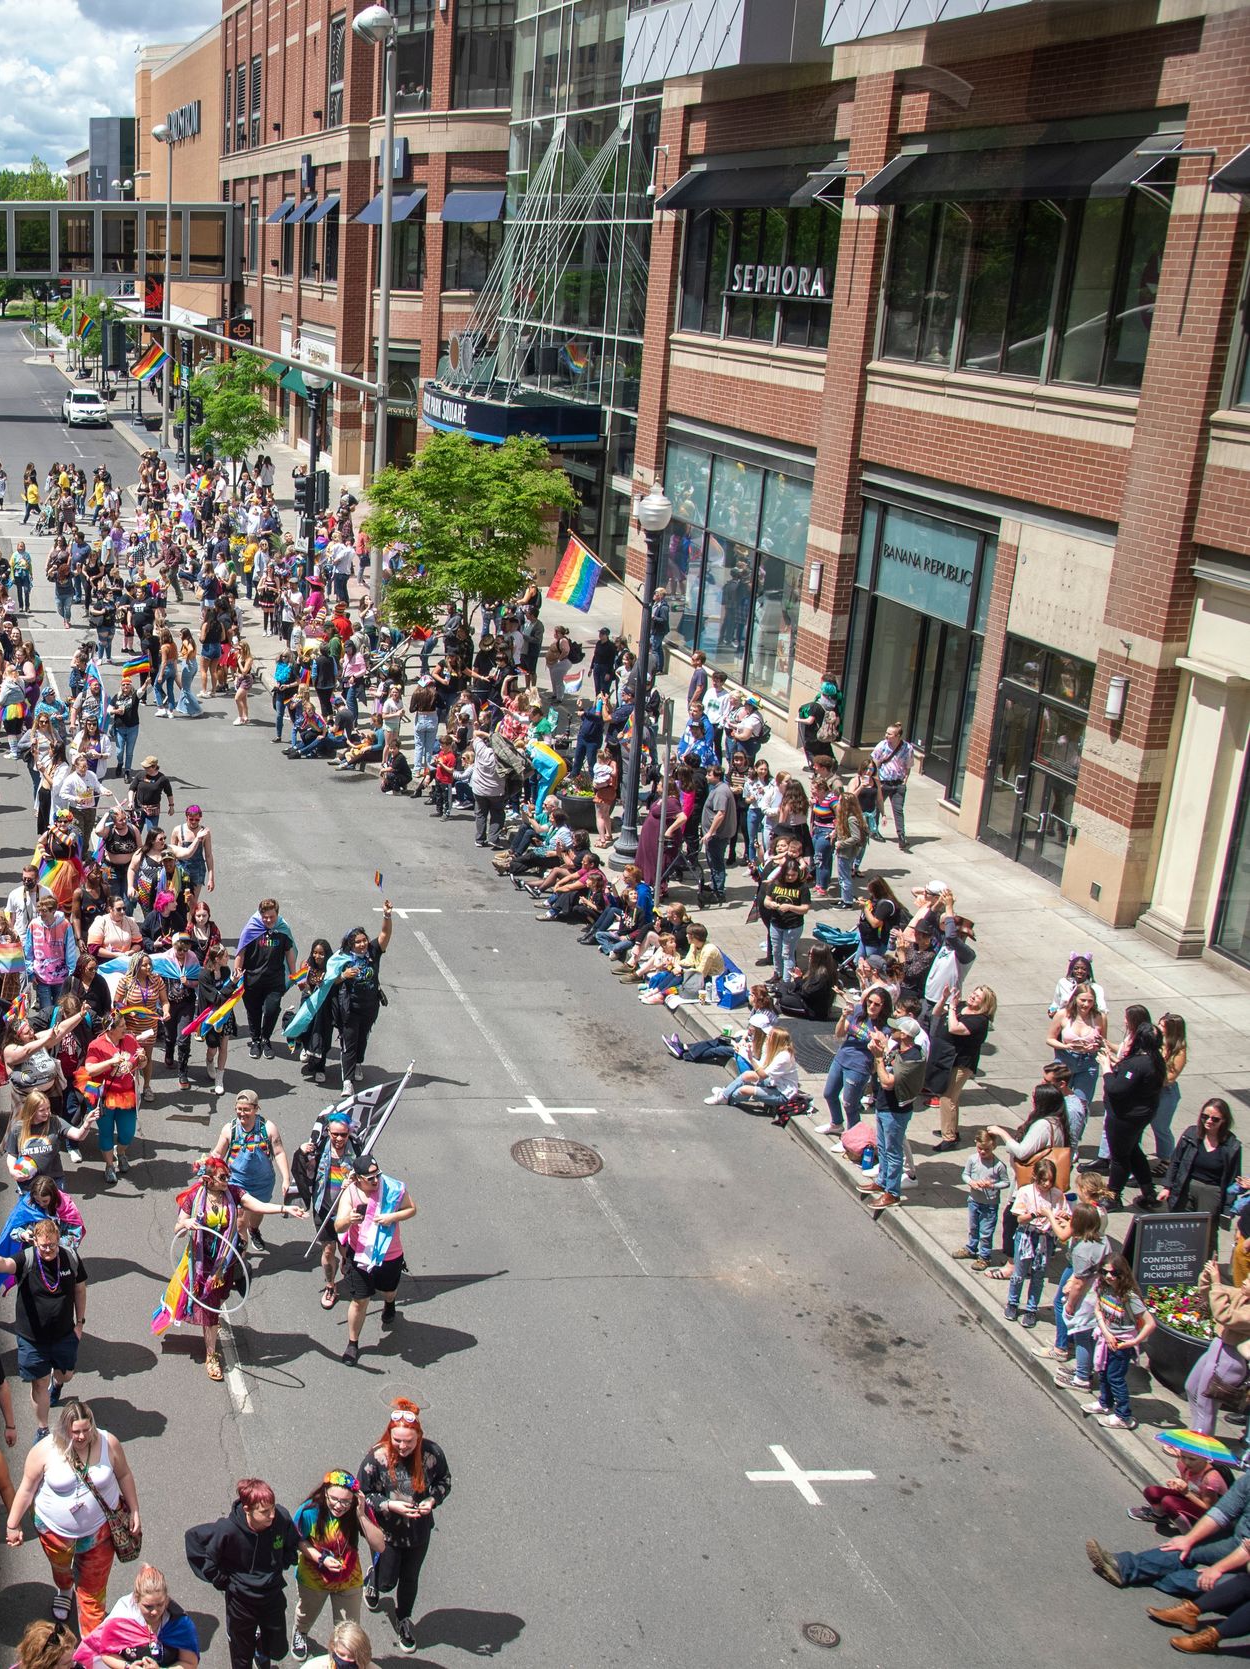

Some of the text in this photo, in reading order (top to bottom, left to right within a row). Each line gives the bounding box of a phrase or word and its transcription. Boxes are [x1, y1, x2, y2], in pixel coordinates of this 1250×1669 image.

[732, 264, 826, 296] SEPHORA
[442, 399, 467, 425] SQUARE
[883, 543, 973, 587] BANANA REPUBLIC
[1142, 1255, 1196, 1263] CONTACTLESS
[1150, 1263, 1188, 1271] CURBSIDE
[1143, 1270, 1193, 1279] PICKUP HERE
